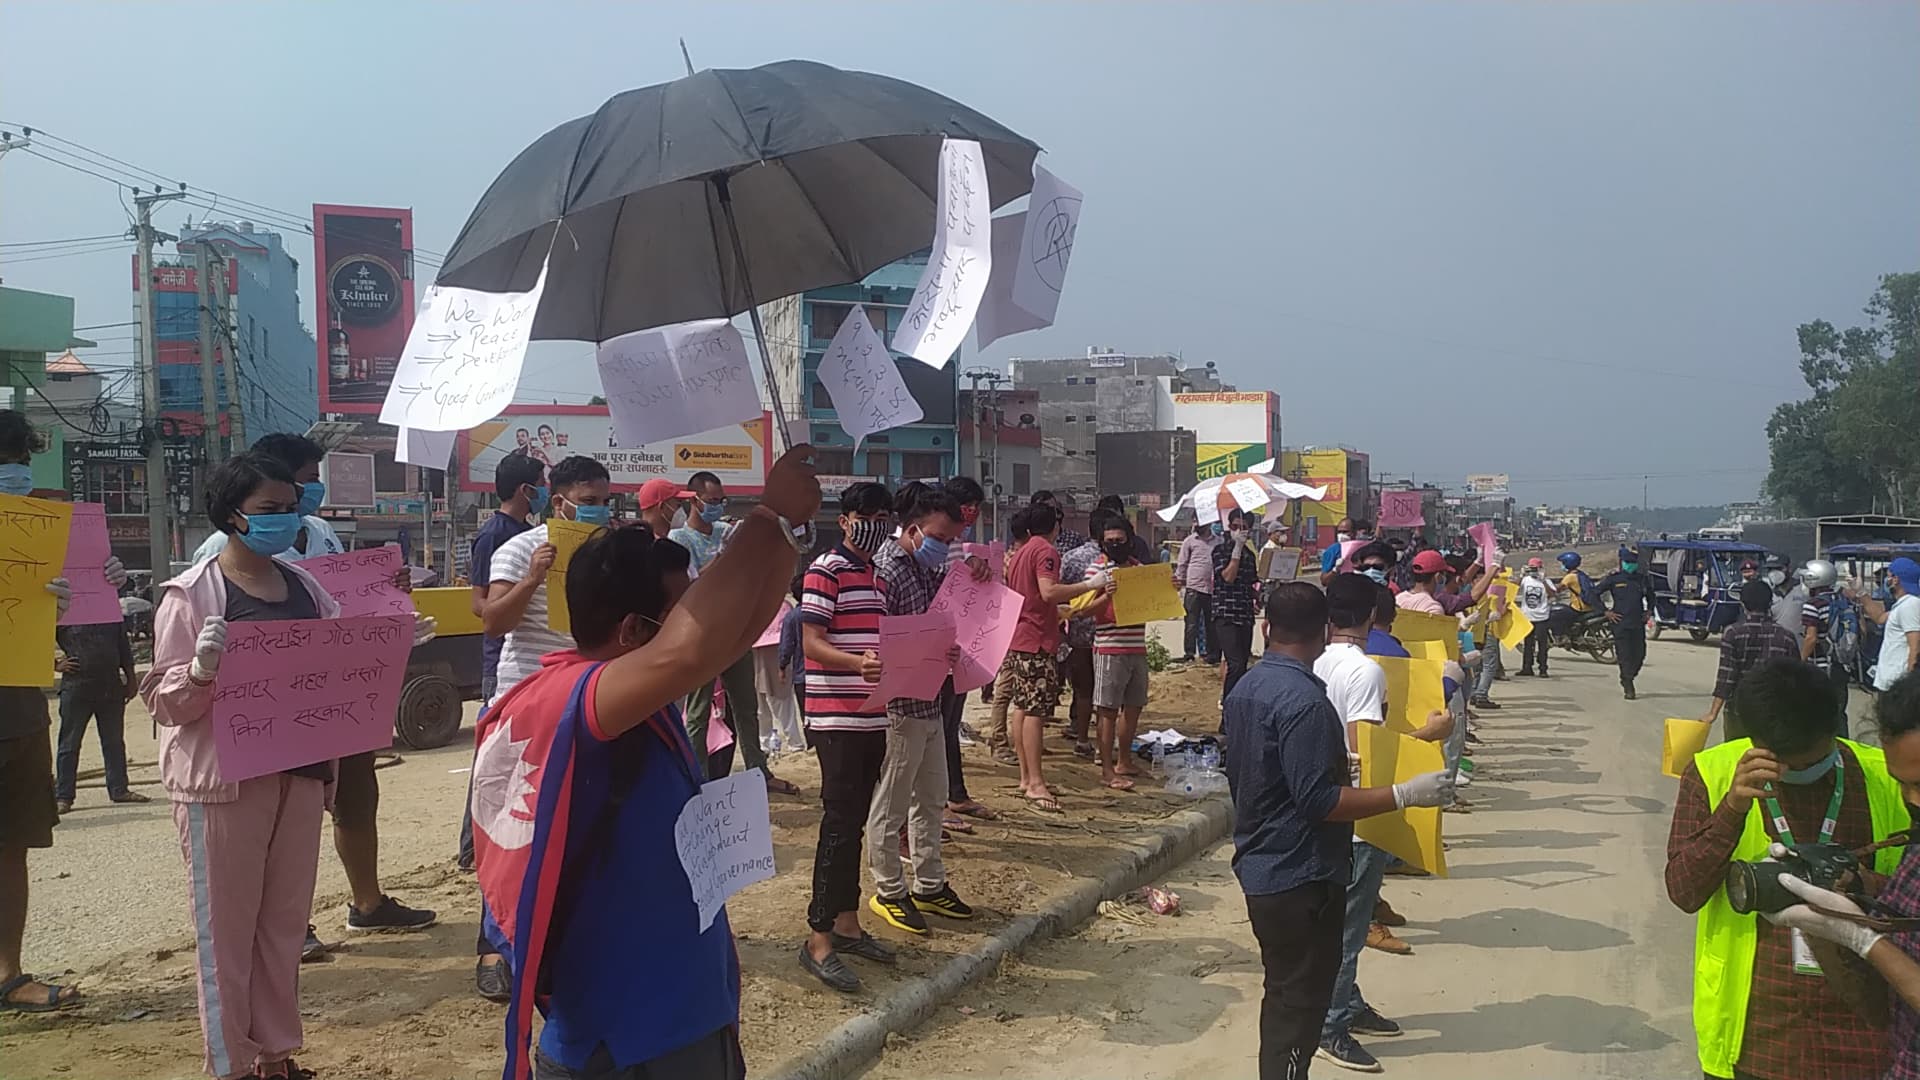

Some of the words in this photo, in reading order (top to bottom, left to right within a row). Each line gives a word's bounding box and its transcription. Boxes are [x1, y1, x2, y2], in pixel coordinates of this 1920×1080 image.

[340, 289, 389, 301] Khukri
[445, 296, 481, 323] We
[471, 324, 518, 352] Peace
[434, 381, 472, 424] Good
[610, 452, 627, 463] पूरा
[630, 451, 663, 464] हुनेछन्
[355, 549, 395, 567] जस्तो
[322, 622, 355, 645] गोठ
[361, 617, 407, 645] जस्तो
[290, 671, 328, 691] महल
[343, 658, 390, 683] जस्तो
[229, 713, 277, 747] किन
[294, 701, 360, 728] सरकार
